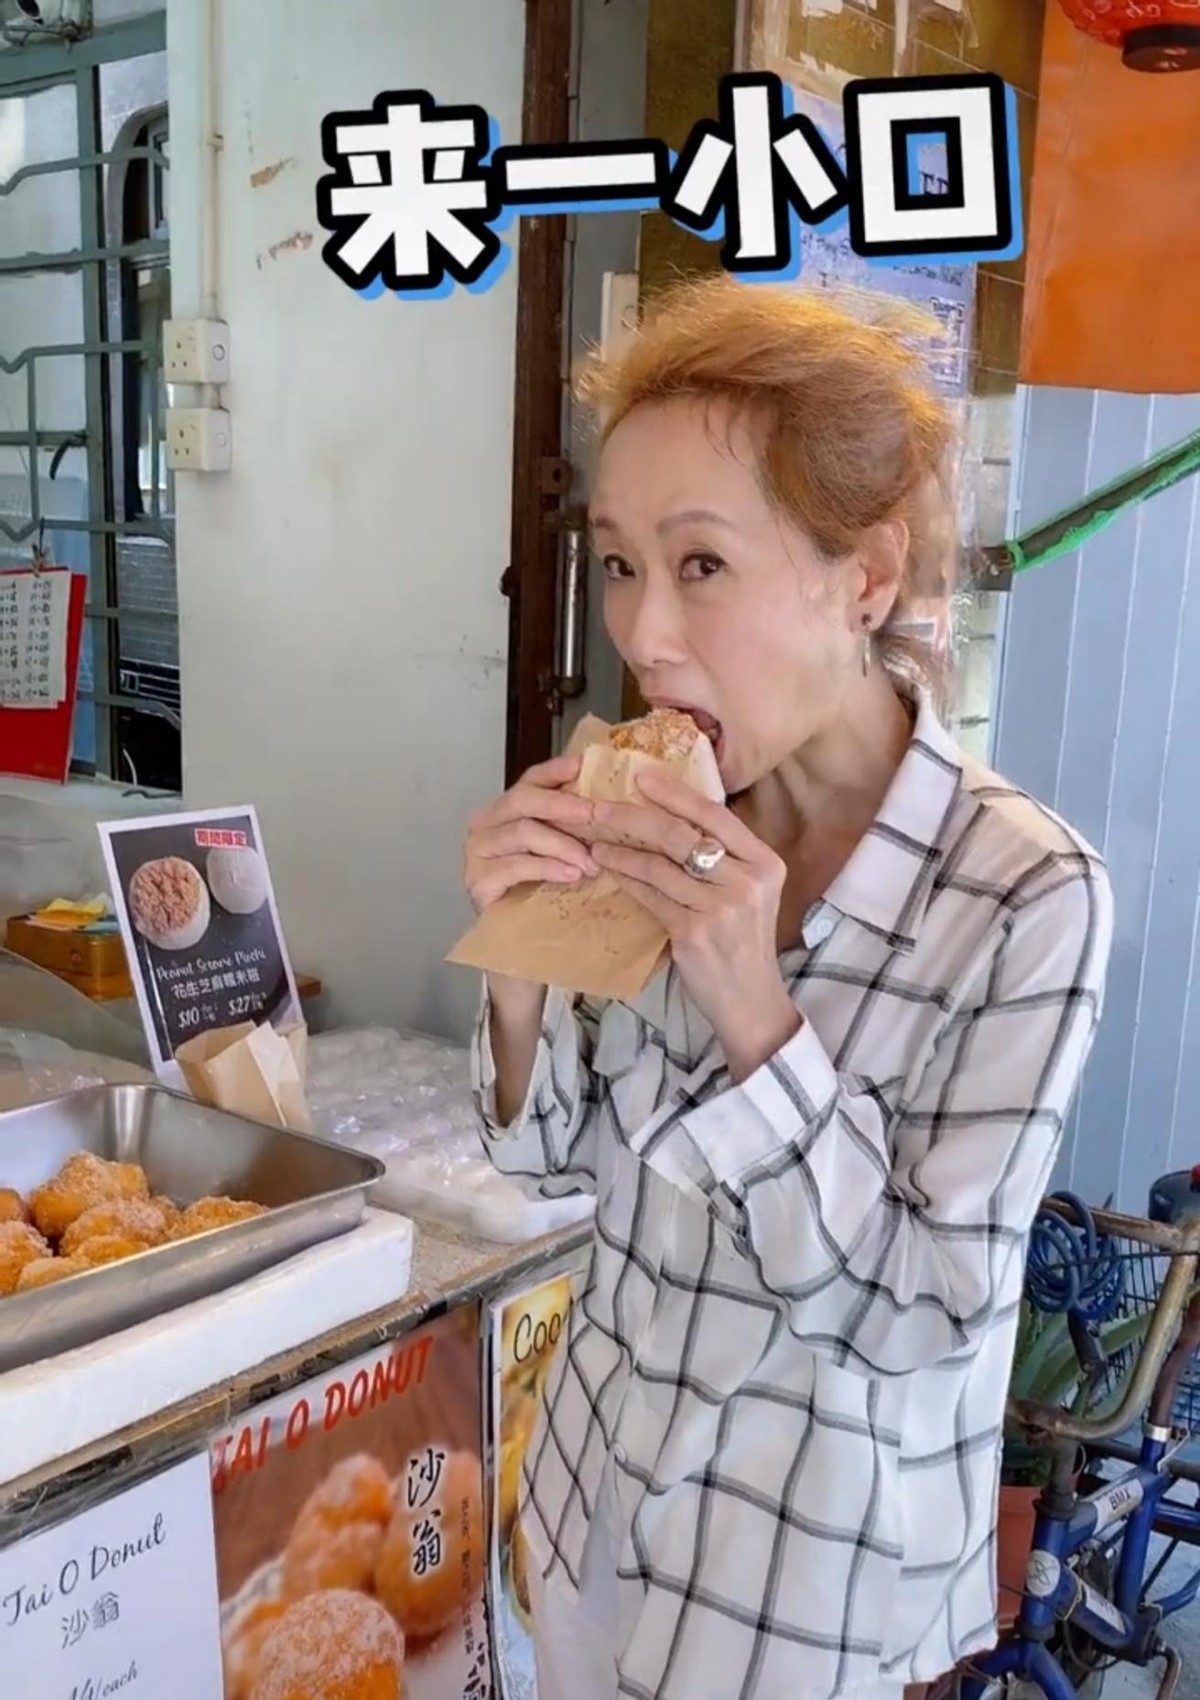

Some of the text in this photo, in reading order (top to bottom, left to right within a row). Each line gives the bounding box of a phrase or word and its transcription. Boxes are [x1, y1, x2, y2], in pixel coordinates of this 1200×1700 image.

[156, 947, 266, 981] Peanut Sesame Mochi
[178, 1006, 199, 1028] $10
[228, 995, 251, 1016] $27
[213, 1336, 433, 1494] TAI O DONUT
[408, 1447, 446, 1576] 沙翁
[1108, 1488, 1131, 1510] BMX
[3, 1512, 166, 1627] Tai O Donut
[61, 1591, 119, 1650] 沙翁
